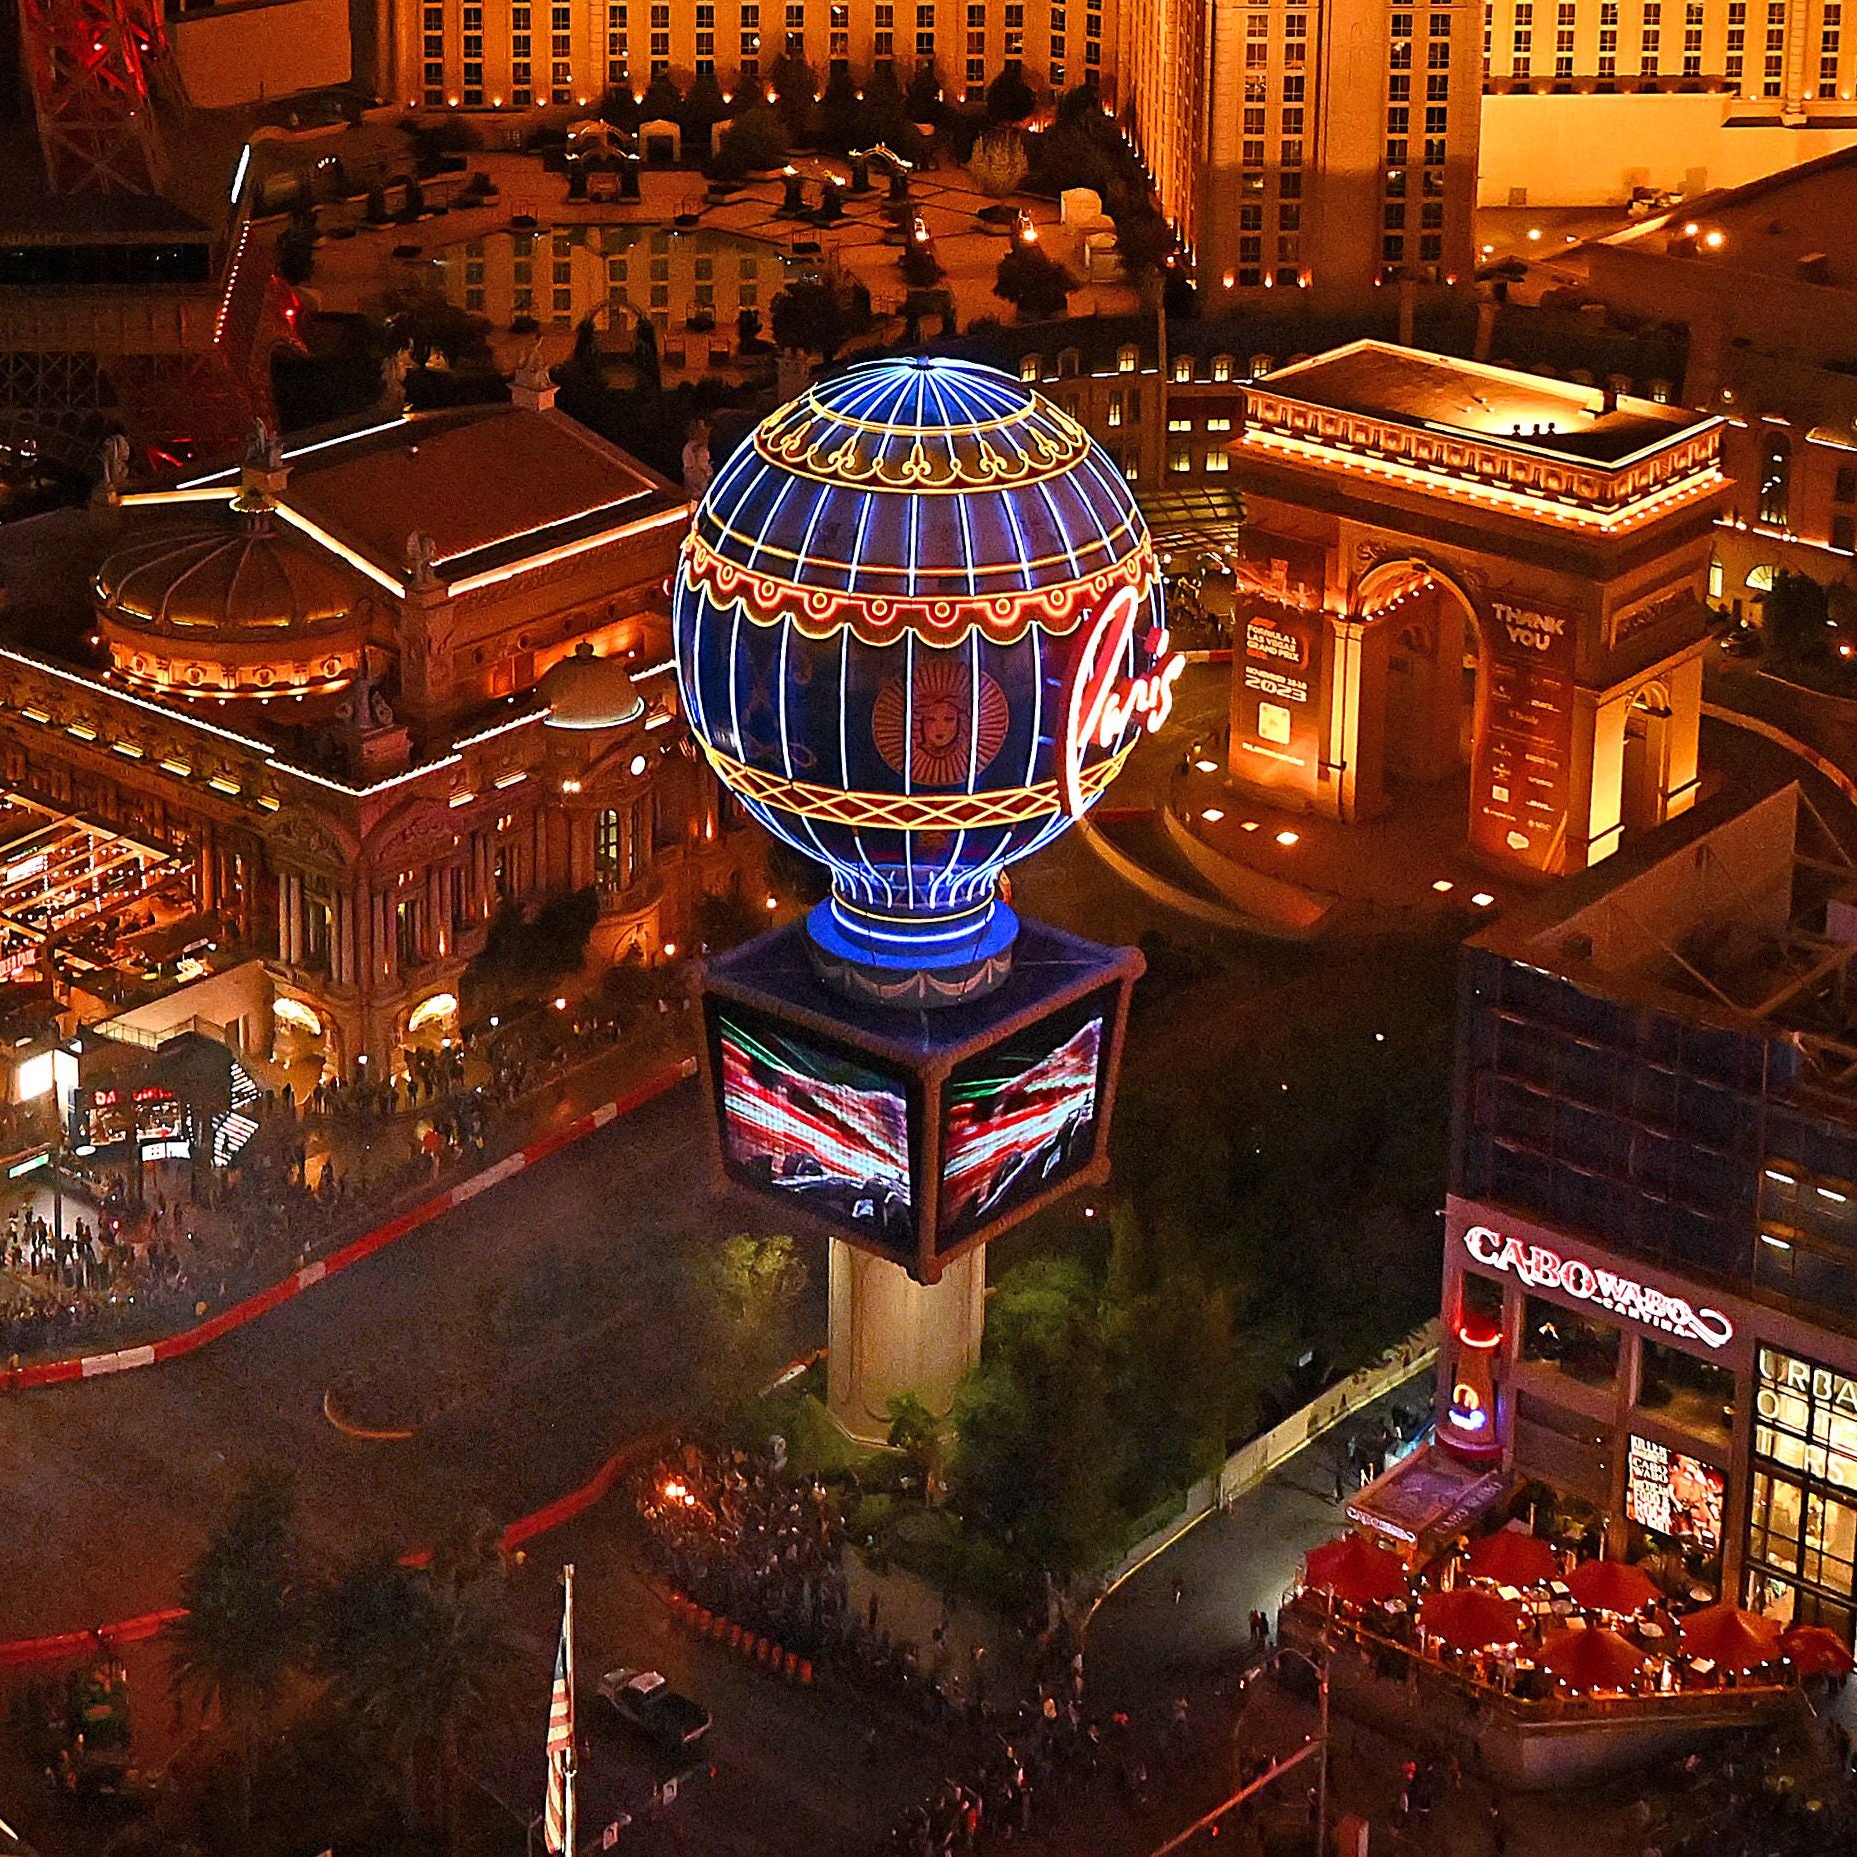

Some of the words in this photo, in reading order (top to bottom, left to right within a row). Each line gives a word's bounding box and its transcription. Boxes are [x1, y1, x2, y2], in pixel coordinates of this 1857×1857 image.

[1505, 623, 1551, 651] YOU
[1065, 584, 1186, 821] Paris
[1244, 673, 1308, 703] 2023
[1463, 1225, 1598, 1300] CABO
[1594, 1269, 1721, 1338] WABO
[1601, 1299, 1688, 1336] CANTINA
